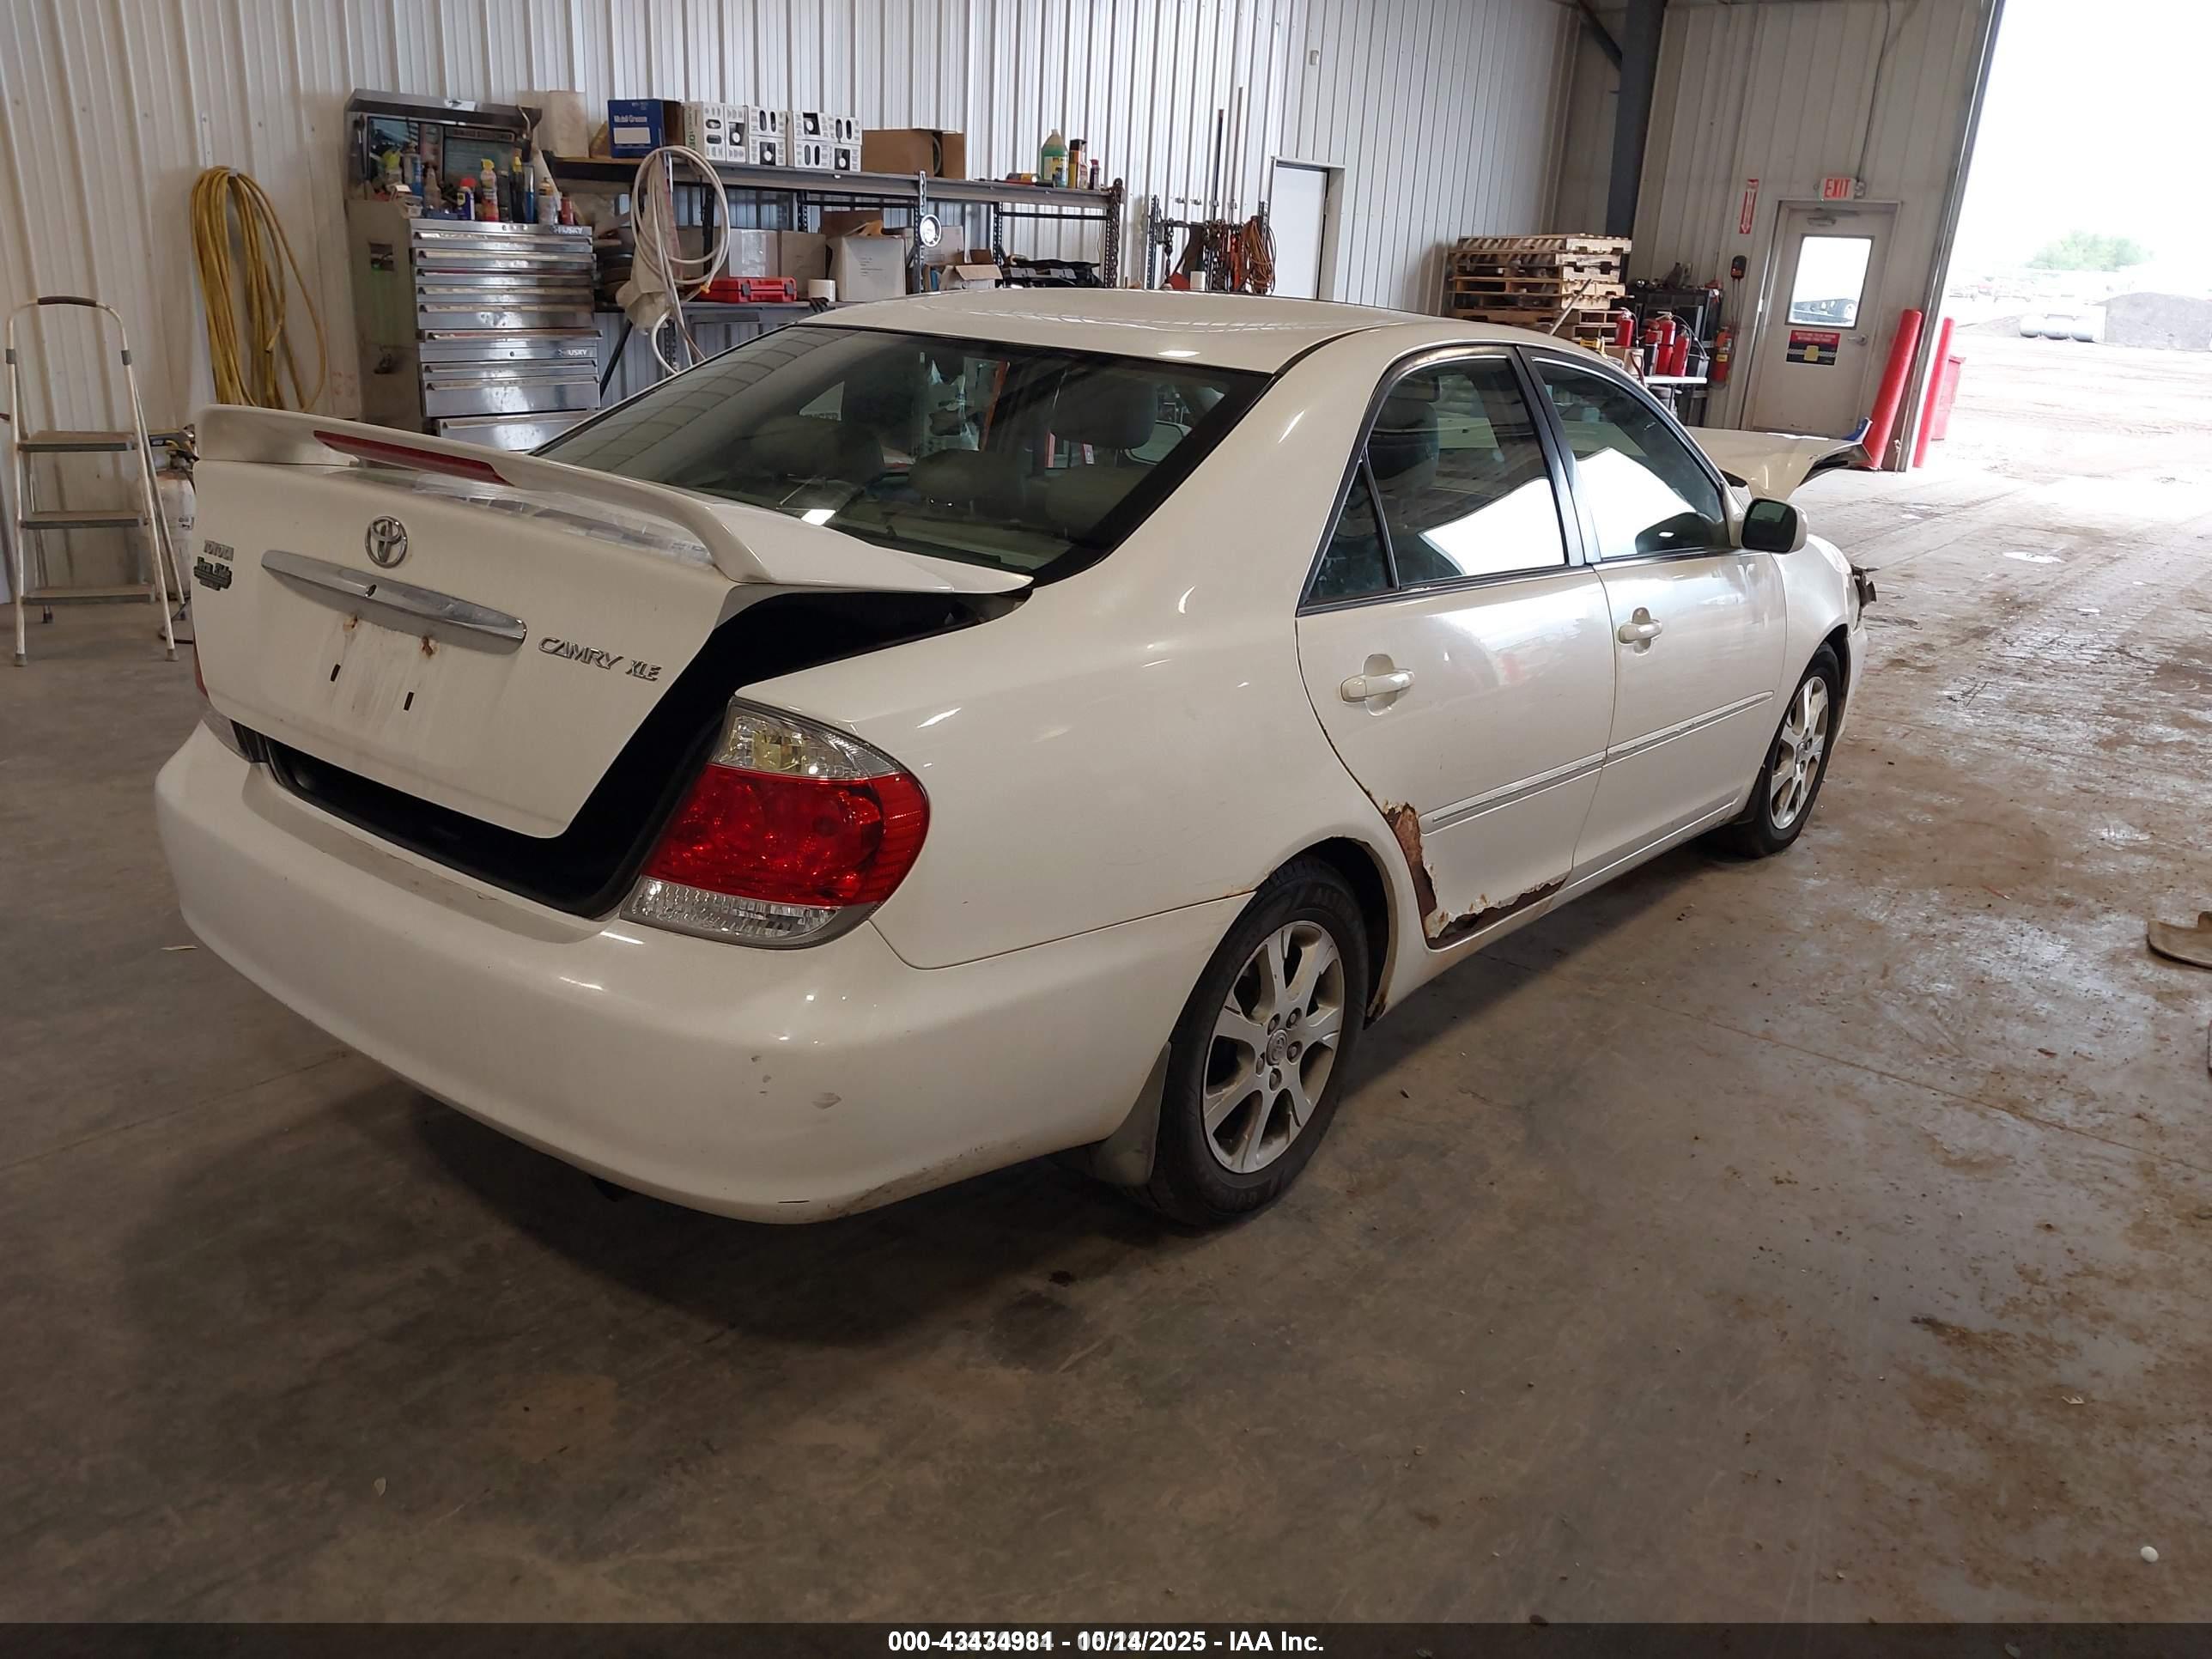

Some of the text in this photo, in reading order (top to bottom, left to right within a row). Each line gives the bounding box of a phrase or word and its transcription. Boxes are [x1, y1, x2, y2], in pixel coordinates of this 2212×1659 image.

[1824, 178, 1851, 198] EXIT
[204, 539, 234, 562] TOYOTA
[538, 637, 662, 682] CAMRY XLE
